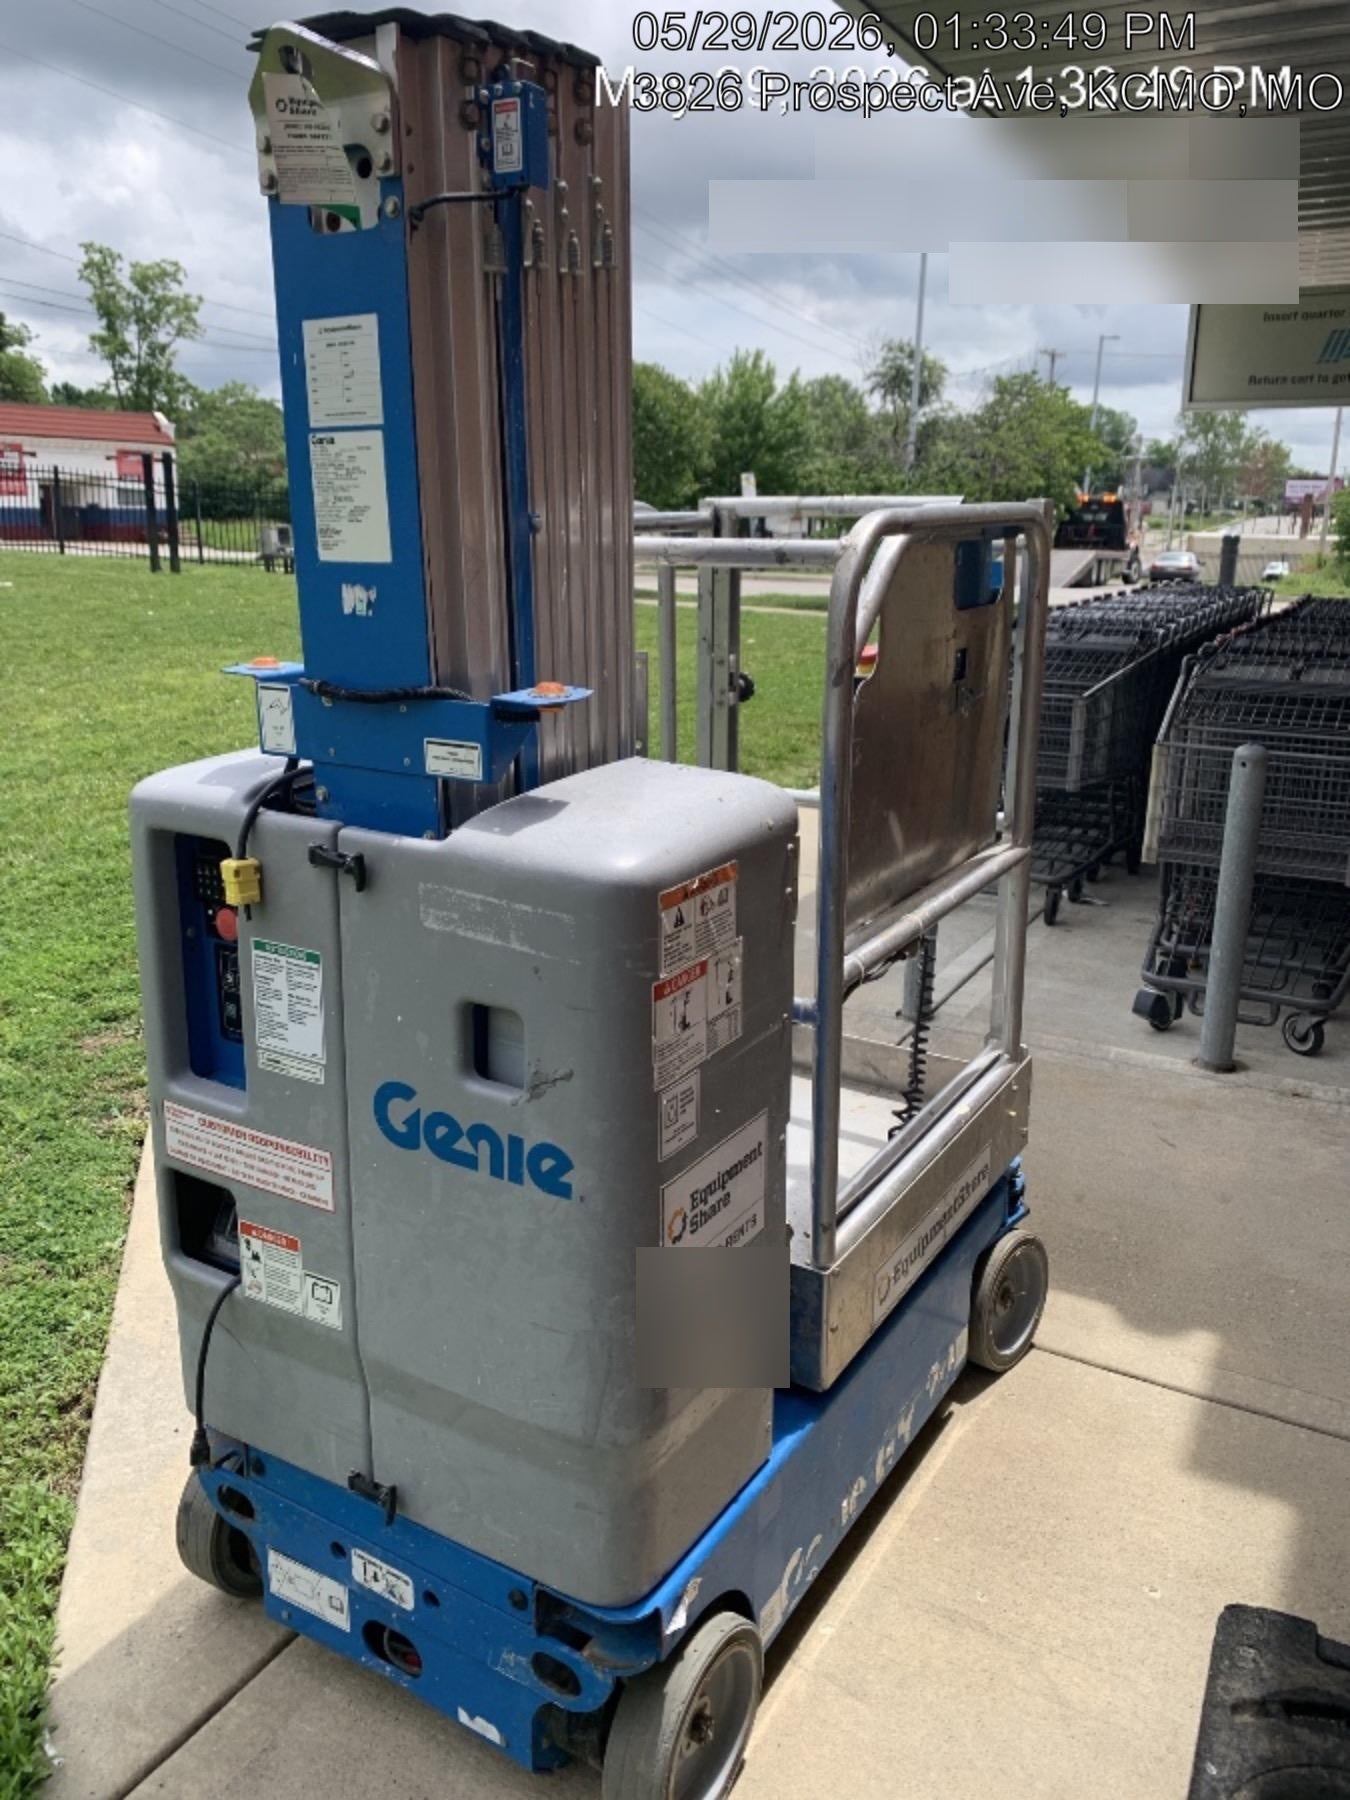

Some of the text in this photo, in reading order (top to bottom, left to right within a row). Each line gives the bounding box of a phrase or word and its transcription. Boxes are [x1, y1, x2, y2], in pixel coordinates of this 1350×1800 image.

[372, 1080, 575, 1201] Genie
[689, 1140, 763, 1213] Equipment
[688, 1190, 732, 1236] Share
